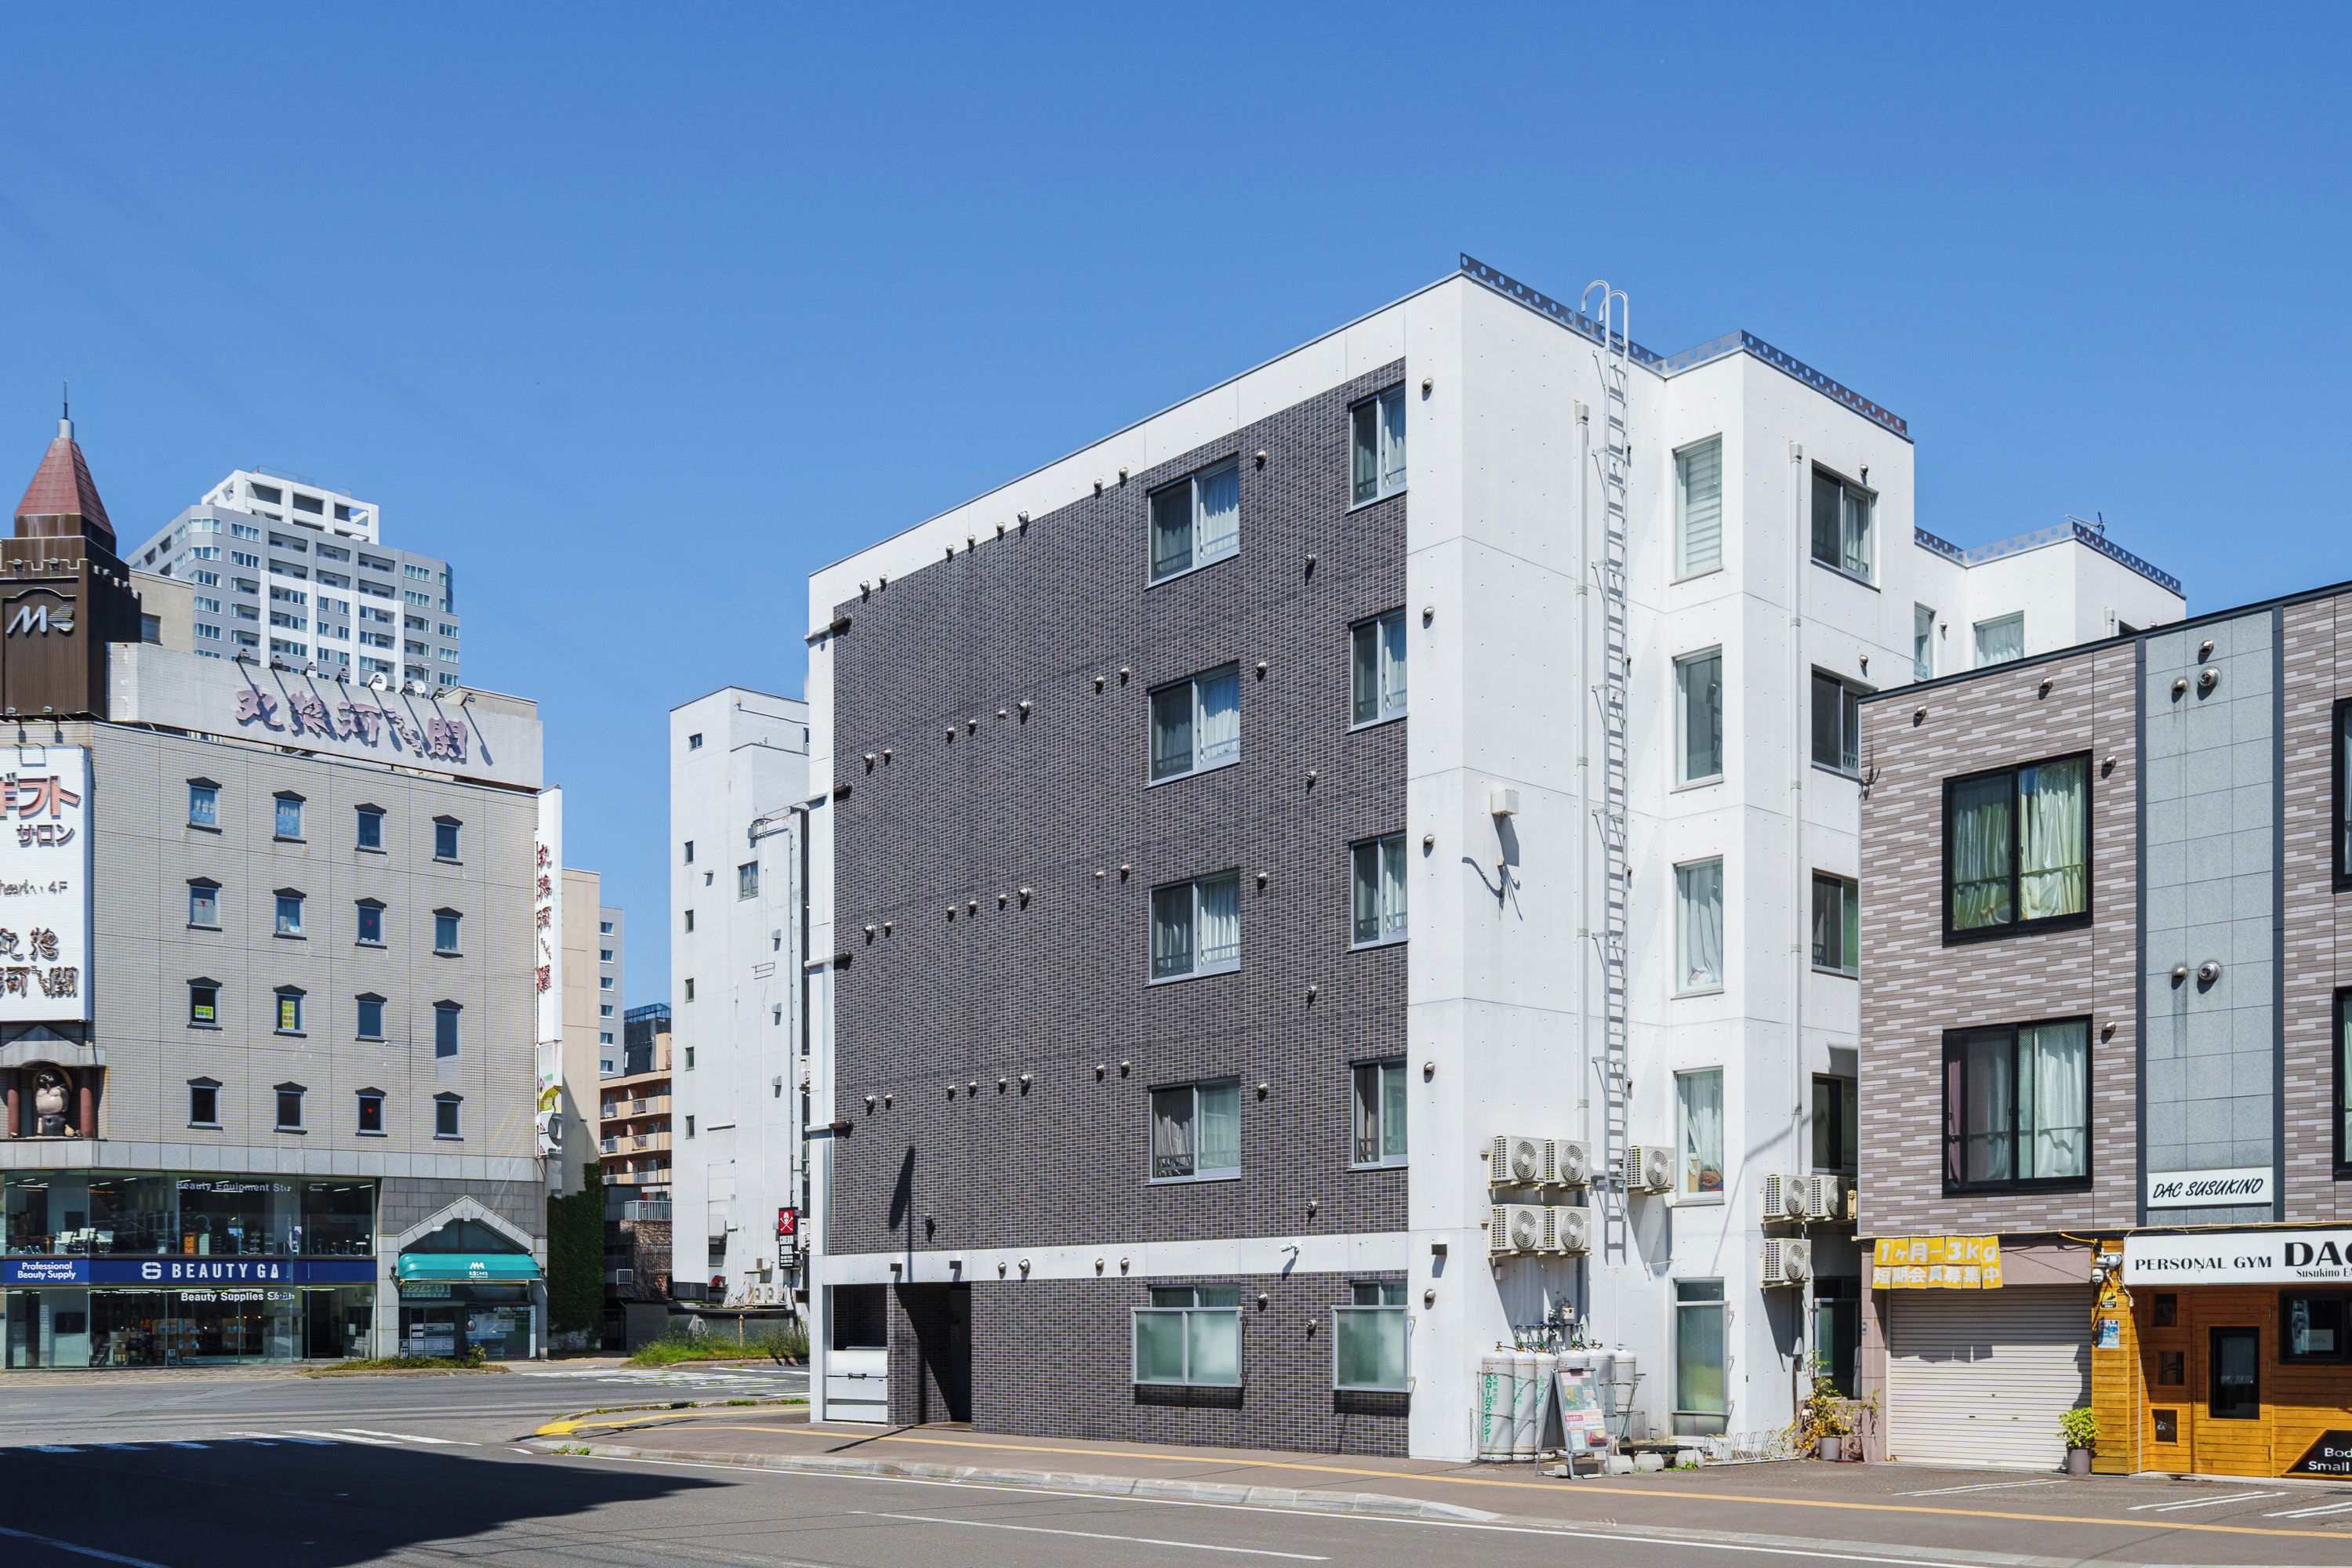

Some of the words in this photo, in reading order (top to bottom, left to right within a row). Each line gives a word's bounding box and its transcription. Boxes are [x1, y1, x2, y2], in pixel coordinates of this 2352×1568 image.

[16, 824, 74, 848] サロン
[176, 1181, 211, 1191] Beauty
[216, 1181, 269, 1192] Equipment
[2153, 1182, 2183, 1199] DAC
[2186, 1178, 2263, 1196] SUSUKINO
[2285, 1241, 2352, 1266] DA
[22, 1261, 72, 1270] Professional
[2135, 1258, 2227, 1270] PERSONAL
[2234, 1256, 2272, 1269] GYM
[17, 1270, 45, 1279] Beauty
[47, 1270, 77, 1280] Supply
[172, 1263, 249, 1279] BEAUTY
[1874, 1265, 1998, 1283] 短期会員募集中
[2296, 1269, 2339, 1277] Susukino
[181, 1292, 216, 1301] Beauty
[220, 1292, 263, 1301] Supplies
[2308, 1461, 2350, 1472] Small
